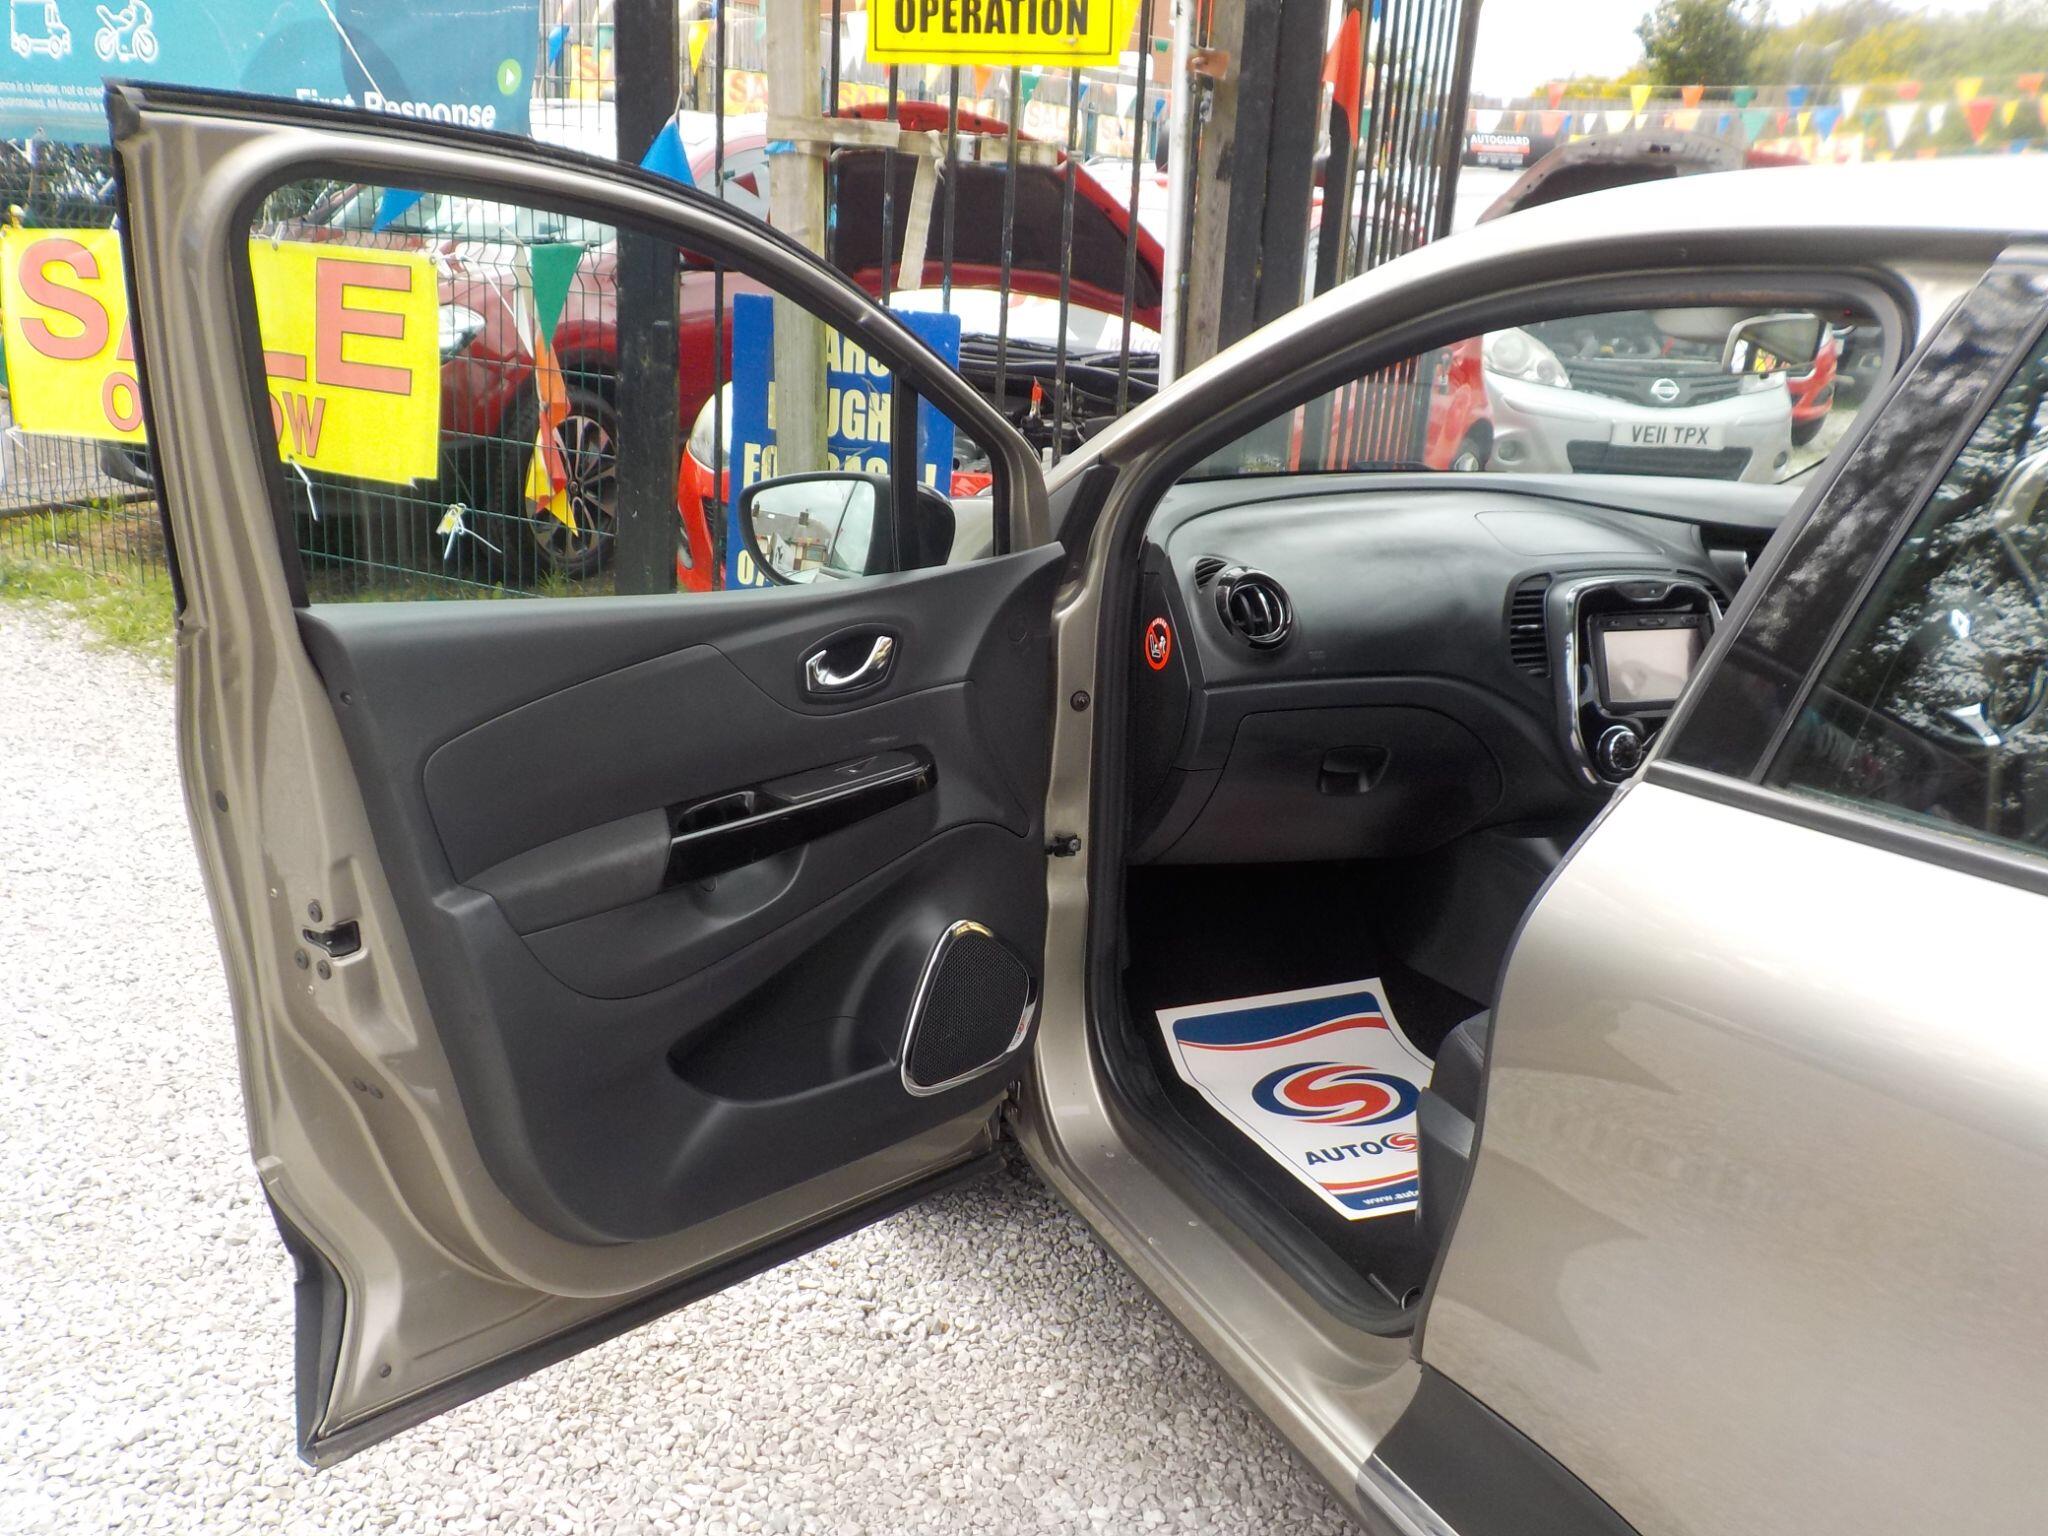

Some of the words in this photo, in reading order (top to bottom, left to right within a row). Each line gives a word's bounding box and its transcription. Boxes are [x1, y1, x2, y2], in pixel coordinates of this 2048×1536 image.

[894, 0, 1088, 36] OPERATION
[1470, 133, 1530, 145] AUTOGUARD
[18, 238, 412, 396] SE
[1631, 425, 1668, 444] VE11
[1674, 426, 1711, 445] TPX
